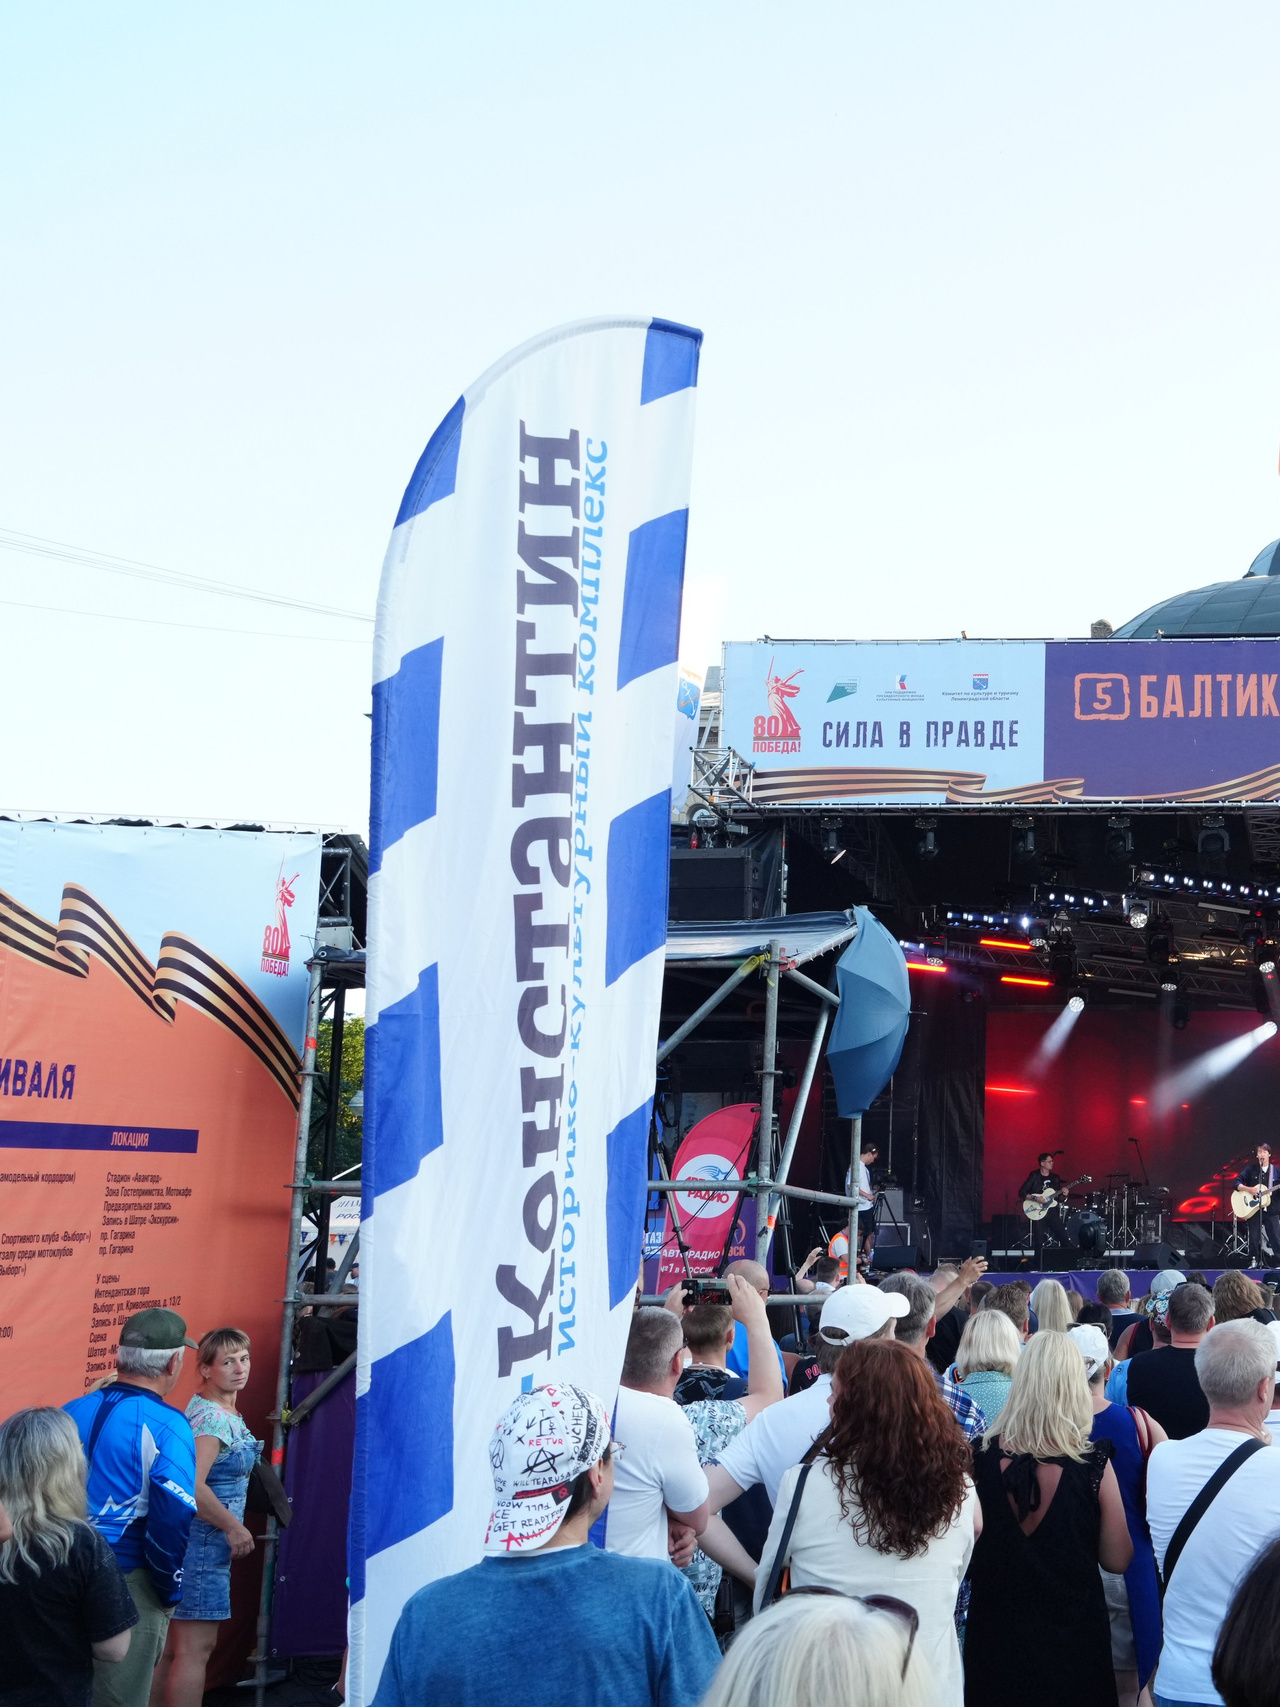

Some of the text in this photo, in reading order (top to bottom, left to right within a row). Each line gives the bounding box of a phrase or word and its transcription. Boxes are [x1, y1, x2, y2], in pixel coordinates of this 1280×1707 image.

[575, 437, 608, 696] комплекс
[1092, 681, 1112, 710] 5
[1139, 673, 1280, 719] БАЛТИК
[753, 715, 780, 737] 80
[822, 719, 1019, 750] СИЛА В ПРАВДЕ
[752, 741, 801, 754] ПОБЕДА!
[496, 419, 581, 1377] Константин
[263, 925, 280, 955] 80
[260, 958, 290, 978] ПОБЕДА!
[111, 1131, 150, 1150] ЛОКАЦИЯ
[106, 1171, 131, 1184] Стадион
[105, 1186, 120, 1197] Зона
[165, 1186, 193, 1199] Мотокафе
[103, 1200, 172, 1213] Предварительная запись
[102, 1215, 123, 1226] Запись
[128, 1215, 147, 1227] Шатре
[1, 1233, 40, 1246] Спортивного
[41, 1231, 60, 1245] клуба
[110, 1229, 136, 1242] Гагарина
[17, 1249, 37, 1261] среди
[37, 1246, 74, 1259] мотоклубов
[109, 1244, 134, 1256] Гагарина
[102, 1274, 120, 1284] сцены
[94, 1286, 150, 1299] Интендантская гора
[169, 1295, 182, 1307] 13/2
[91, 1317, 112, 1329] Запись
[89, 1332, 107, 1344] Сцена
[87, 1346, 107, 1359] Шатер
[85, 1361, 107, 1373] Запись
